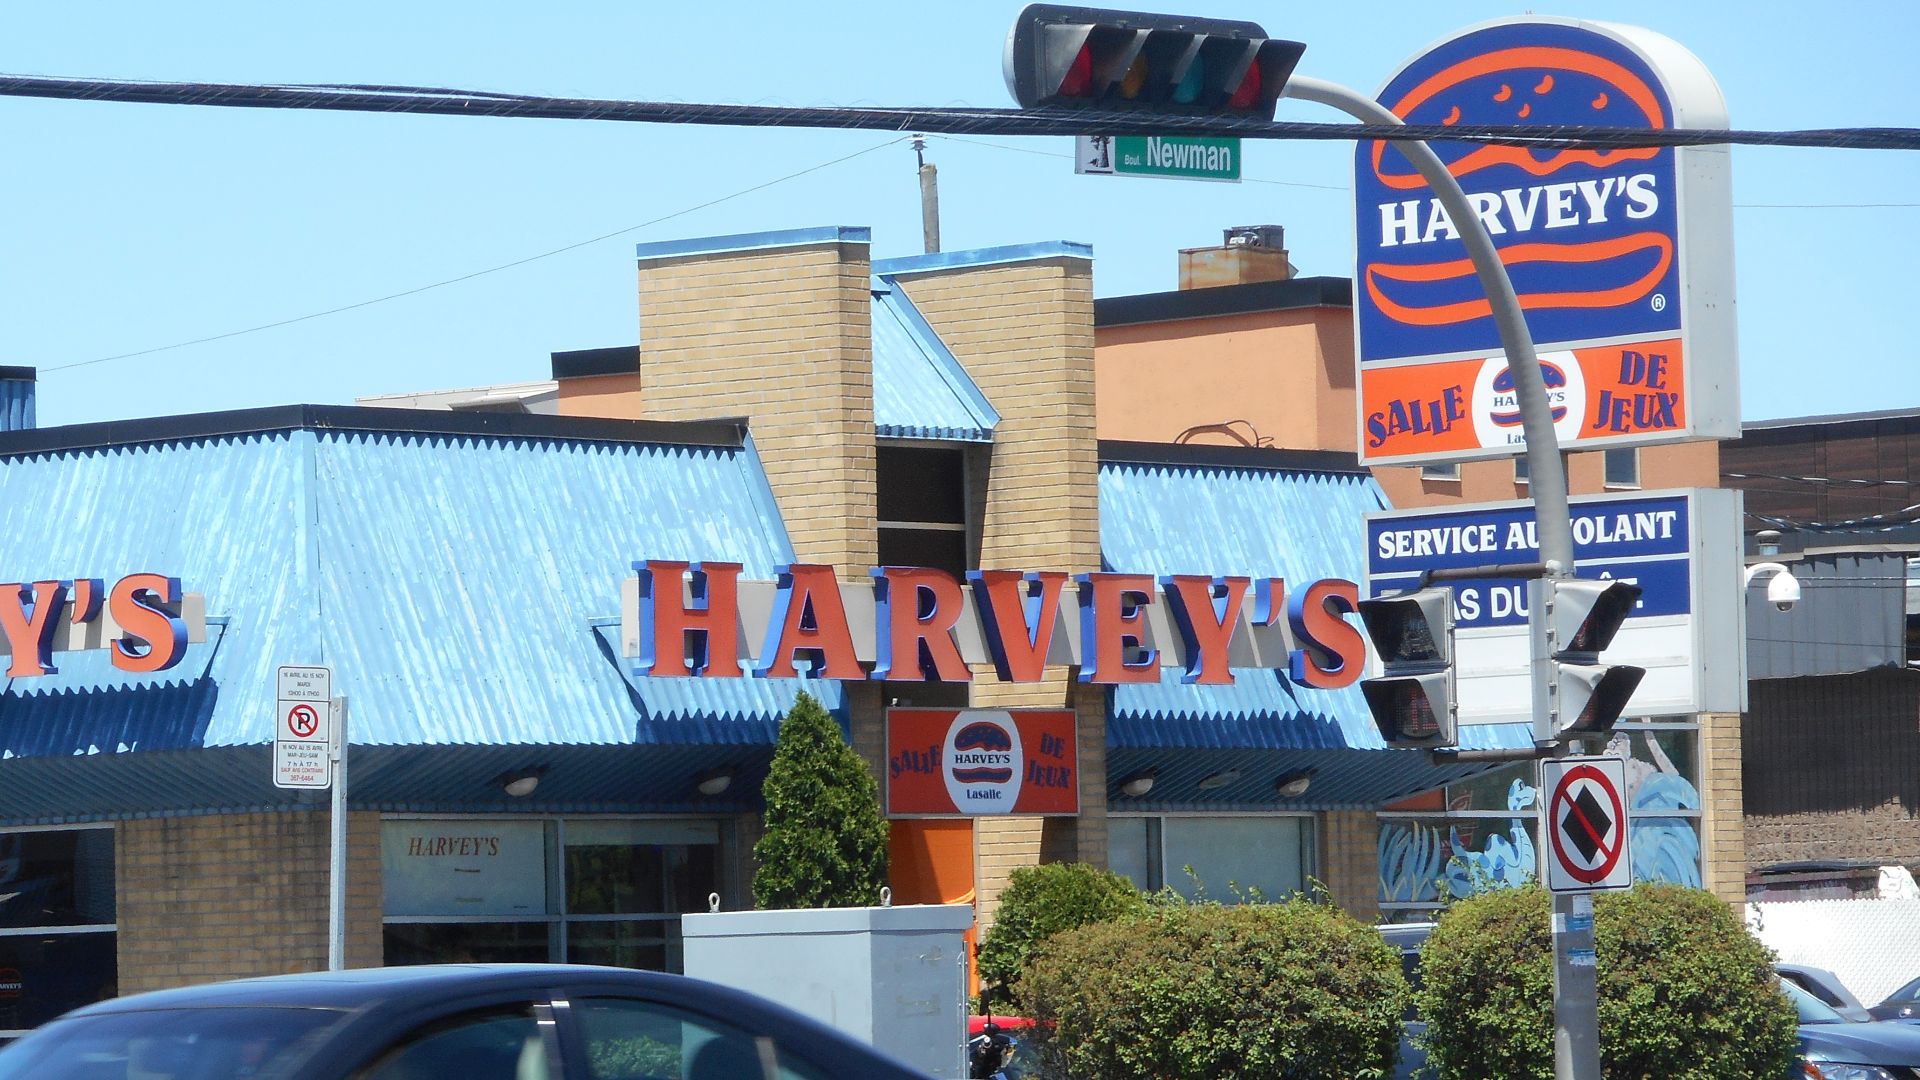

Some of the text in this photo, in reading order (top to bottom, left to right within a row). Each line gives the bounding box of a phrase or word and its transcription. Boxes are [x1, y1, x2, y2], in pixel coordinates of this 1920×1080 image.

[1146, 136, 1232, 172] Newman
[1378, 173, 1659, 248] HARVEY'S
[1617, 349, 1668, 390] DE
[1366, 384, 1466, 449] SALLE
[1494, 391, 1566, 407] HAY'S
[1593, 389, 1679, 434] JEUX
[1378, 523, 1498, 560] SERVICE
[1569, 510, 1677, 546] OLANT
[631, 559, 1368, 690] HARVEY'S
[890, 743, 942, 779] SALLE
[955, 753, 1011, 765] HARVEY'S
[1040, 732, 1065, 760] DE
[408, 836, 500, 857] HARVEY'S
